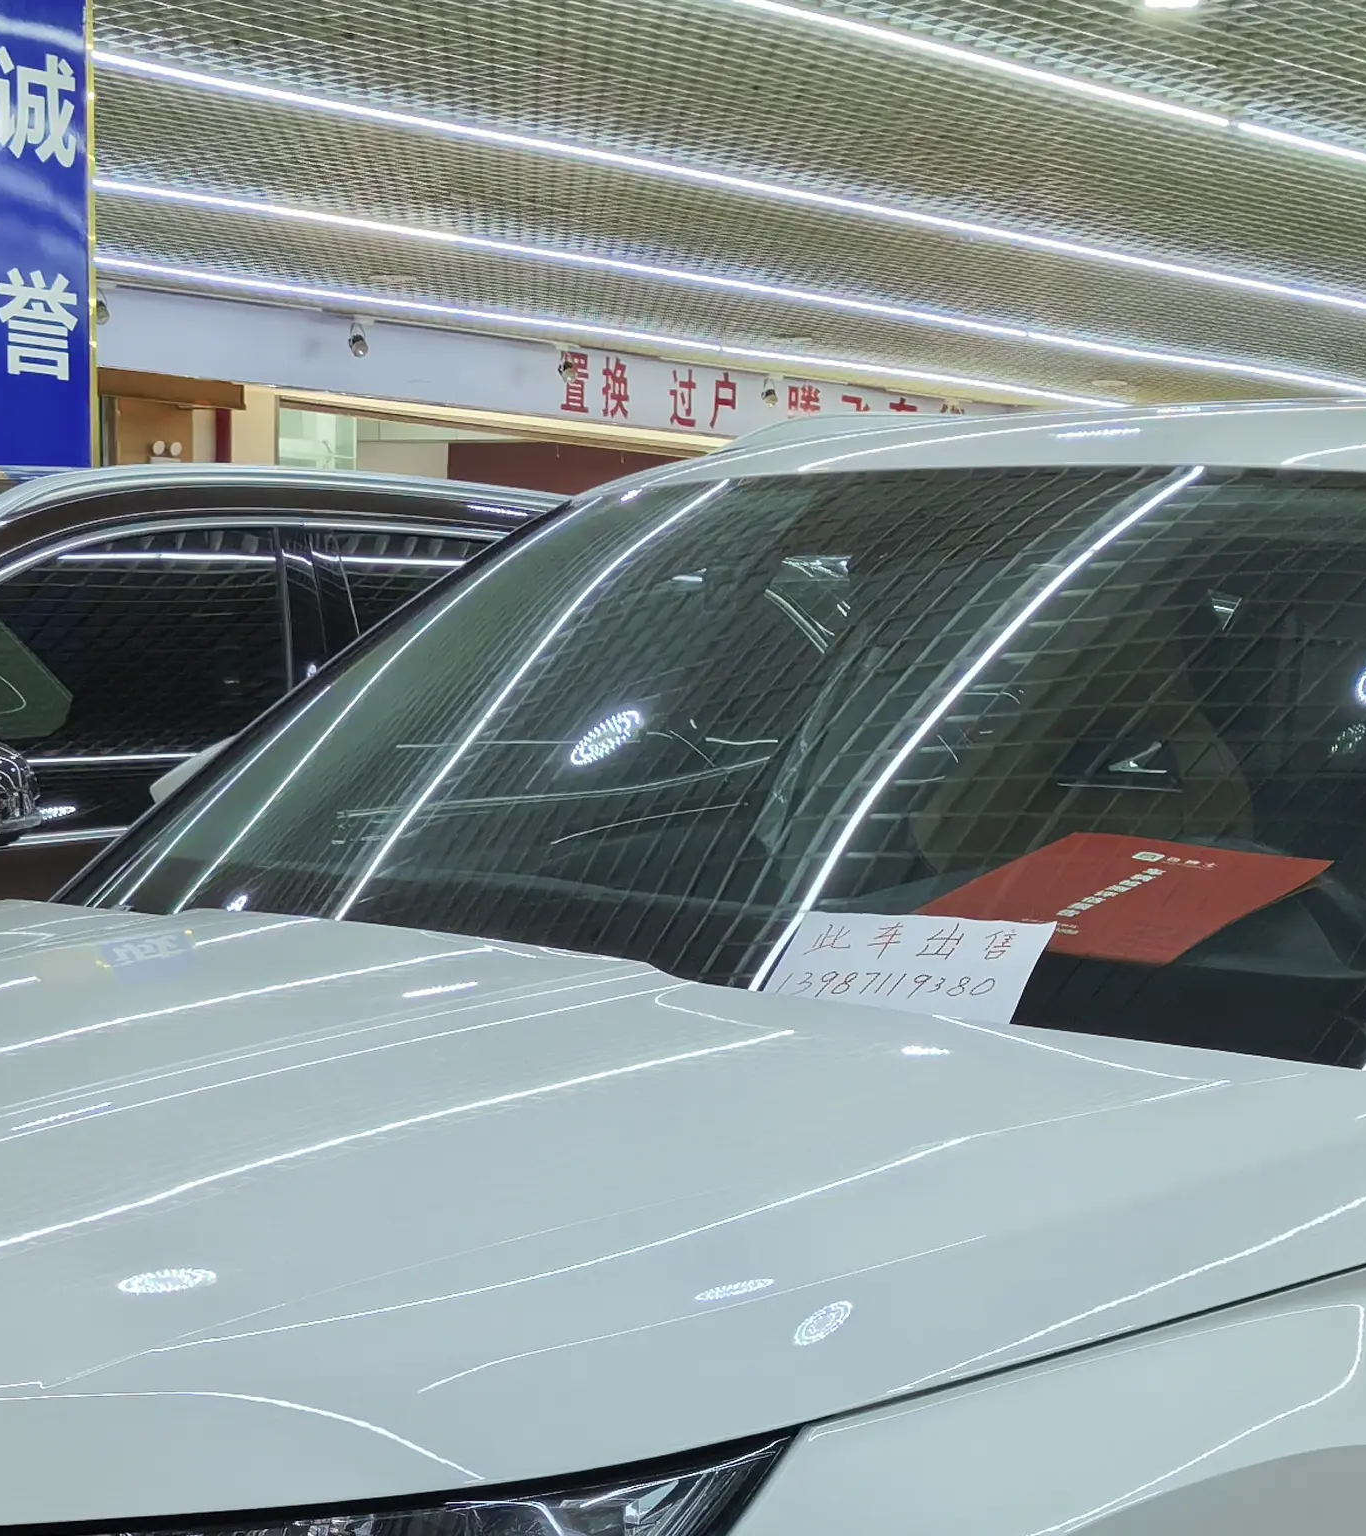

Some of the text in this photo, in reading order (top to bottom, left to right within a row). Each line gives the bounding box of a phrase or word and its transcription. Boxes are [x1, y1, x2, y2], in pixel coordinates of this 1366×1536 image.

[560, 353, 630, 418] 置换
[669, 368, 737, 429] 过户
[802, 921, 1018, 961] 此车出售
[775, 971, 997, 1000] 13987119380
